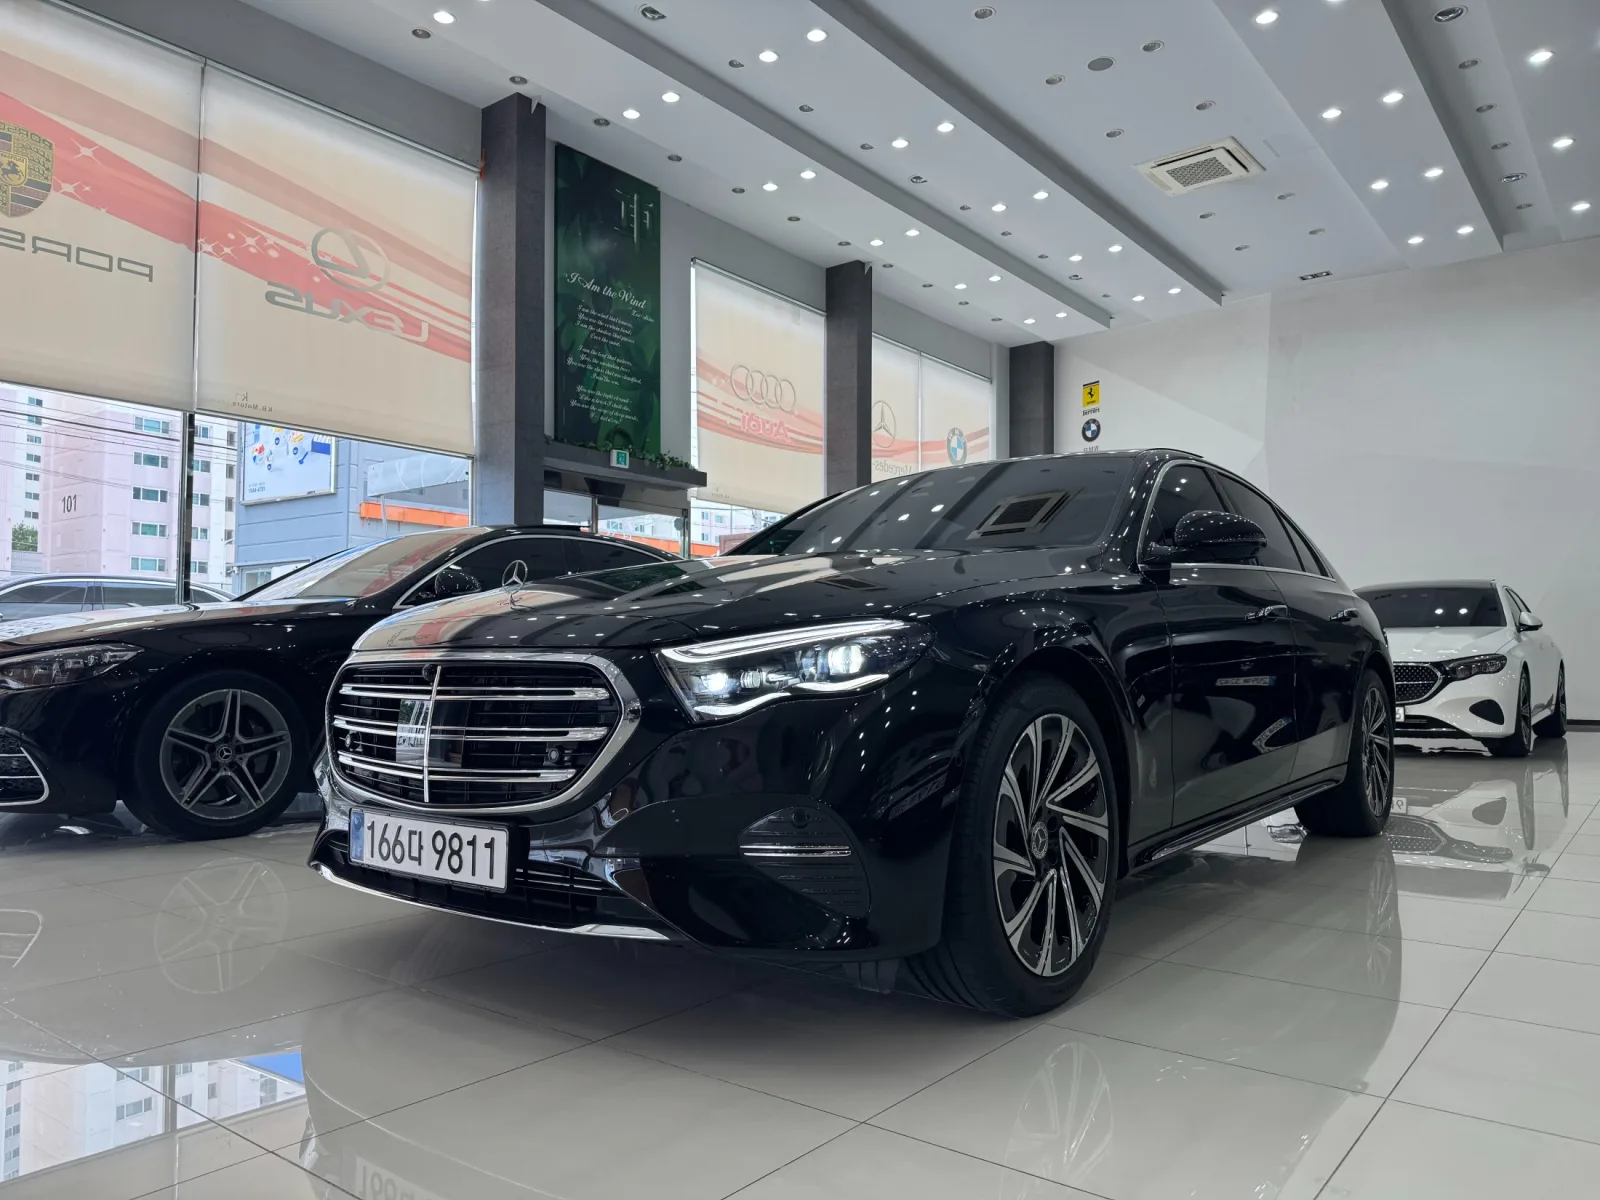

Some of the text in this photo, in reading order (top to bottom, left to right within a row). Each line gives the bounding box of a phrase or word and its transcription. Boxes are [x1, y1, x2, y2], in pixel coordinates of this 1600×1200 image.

[568, 272, 647, 308] I Am the Wind
[62, 495, 77, 514] 101
[367, 820, 496, 880] 166다 9811
